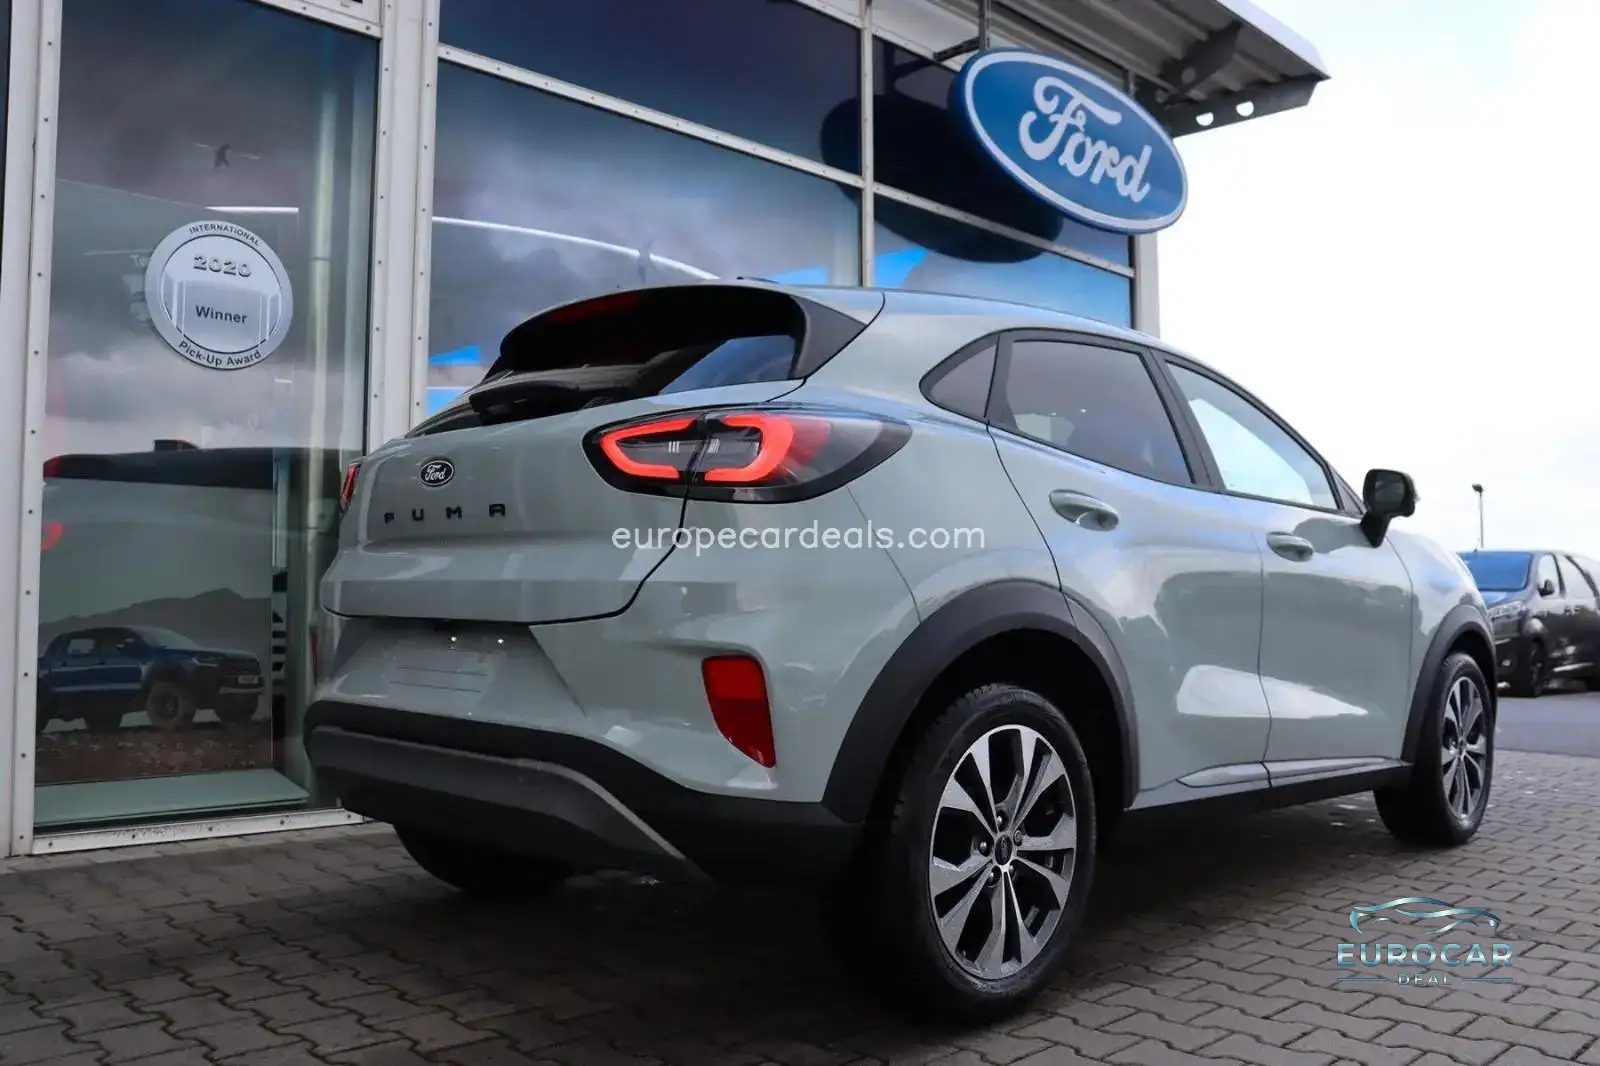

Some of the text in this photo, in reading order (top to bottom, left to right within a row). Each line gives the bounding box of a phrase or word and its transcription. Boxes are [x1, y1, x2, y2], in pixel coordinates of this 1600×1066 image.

[1019, 76, 1152, 202] Ford
[189, 223, 261, 247] INTERNATIONAL
[193, 255, 252, 278] 2020
[195, 304, 248, 324] Winner
[178, 340, 262, 367] Pick-Up Award
[424, 463, 447, 482] Ford
[384, 503, 507, 524] PUMA
